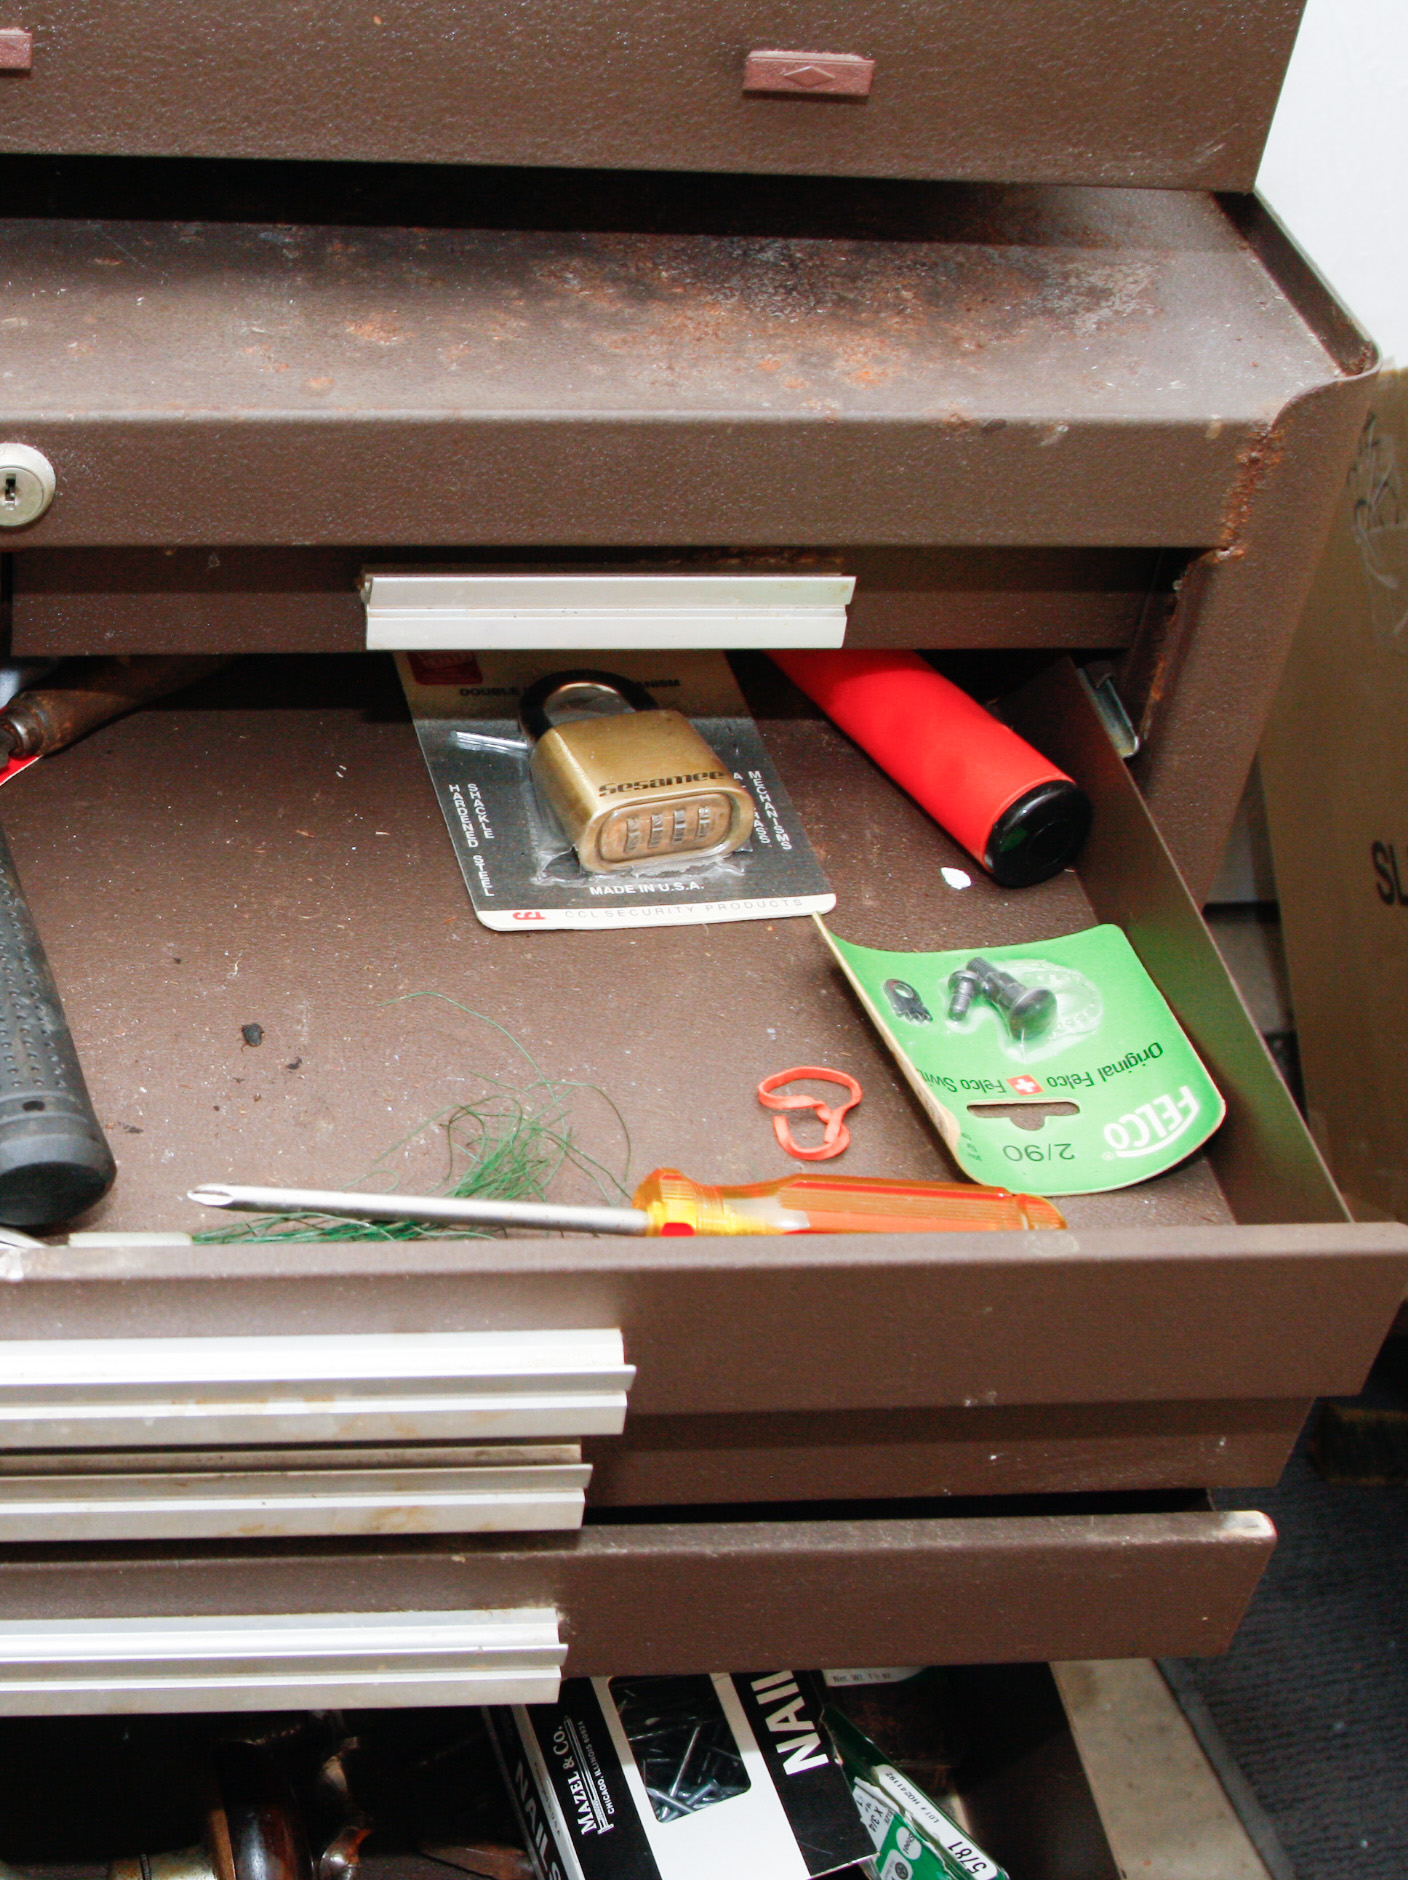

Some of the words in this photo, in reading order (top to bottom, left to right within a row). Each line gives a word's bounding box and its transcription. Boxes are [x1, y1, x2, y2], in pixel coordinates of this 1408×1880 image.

[598, 770, 727, 797] Sesamee
[467, 783, 495, 839] SHACKLE
[748, 770, 792, 850] MECHANISMS
[448, 784, 480, 848] HARDENED
[472, 854, 495, 897] STEEL
[589, 884, 636, 896] MADE
[638, 882, 656, 894] IN
[658, 880, 705, 893] U.S.A.
[564, 909, 599, 920] CCL
[604, 905, 695, 919] SECURITY
[705, 898, 803, 912] PRODUCTS
[1097, 1041, 1164, 1083] Original
[960, 1077, 1008, 1094] Felco
[1046, 1071, 1096, 1090] Felco
[1103, 1084, 1202, 1152] FELCO
[1002, 1142, 1077, 1163] 2/90
[562, 1755, 575, 1770] &
[585, 1744, 602, 1776] ILLINOIS
[568, 1770, 598, 1835] MAZEL
[597, 1776, 615, 1815] CHICAGO,
